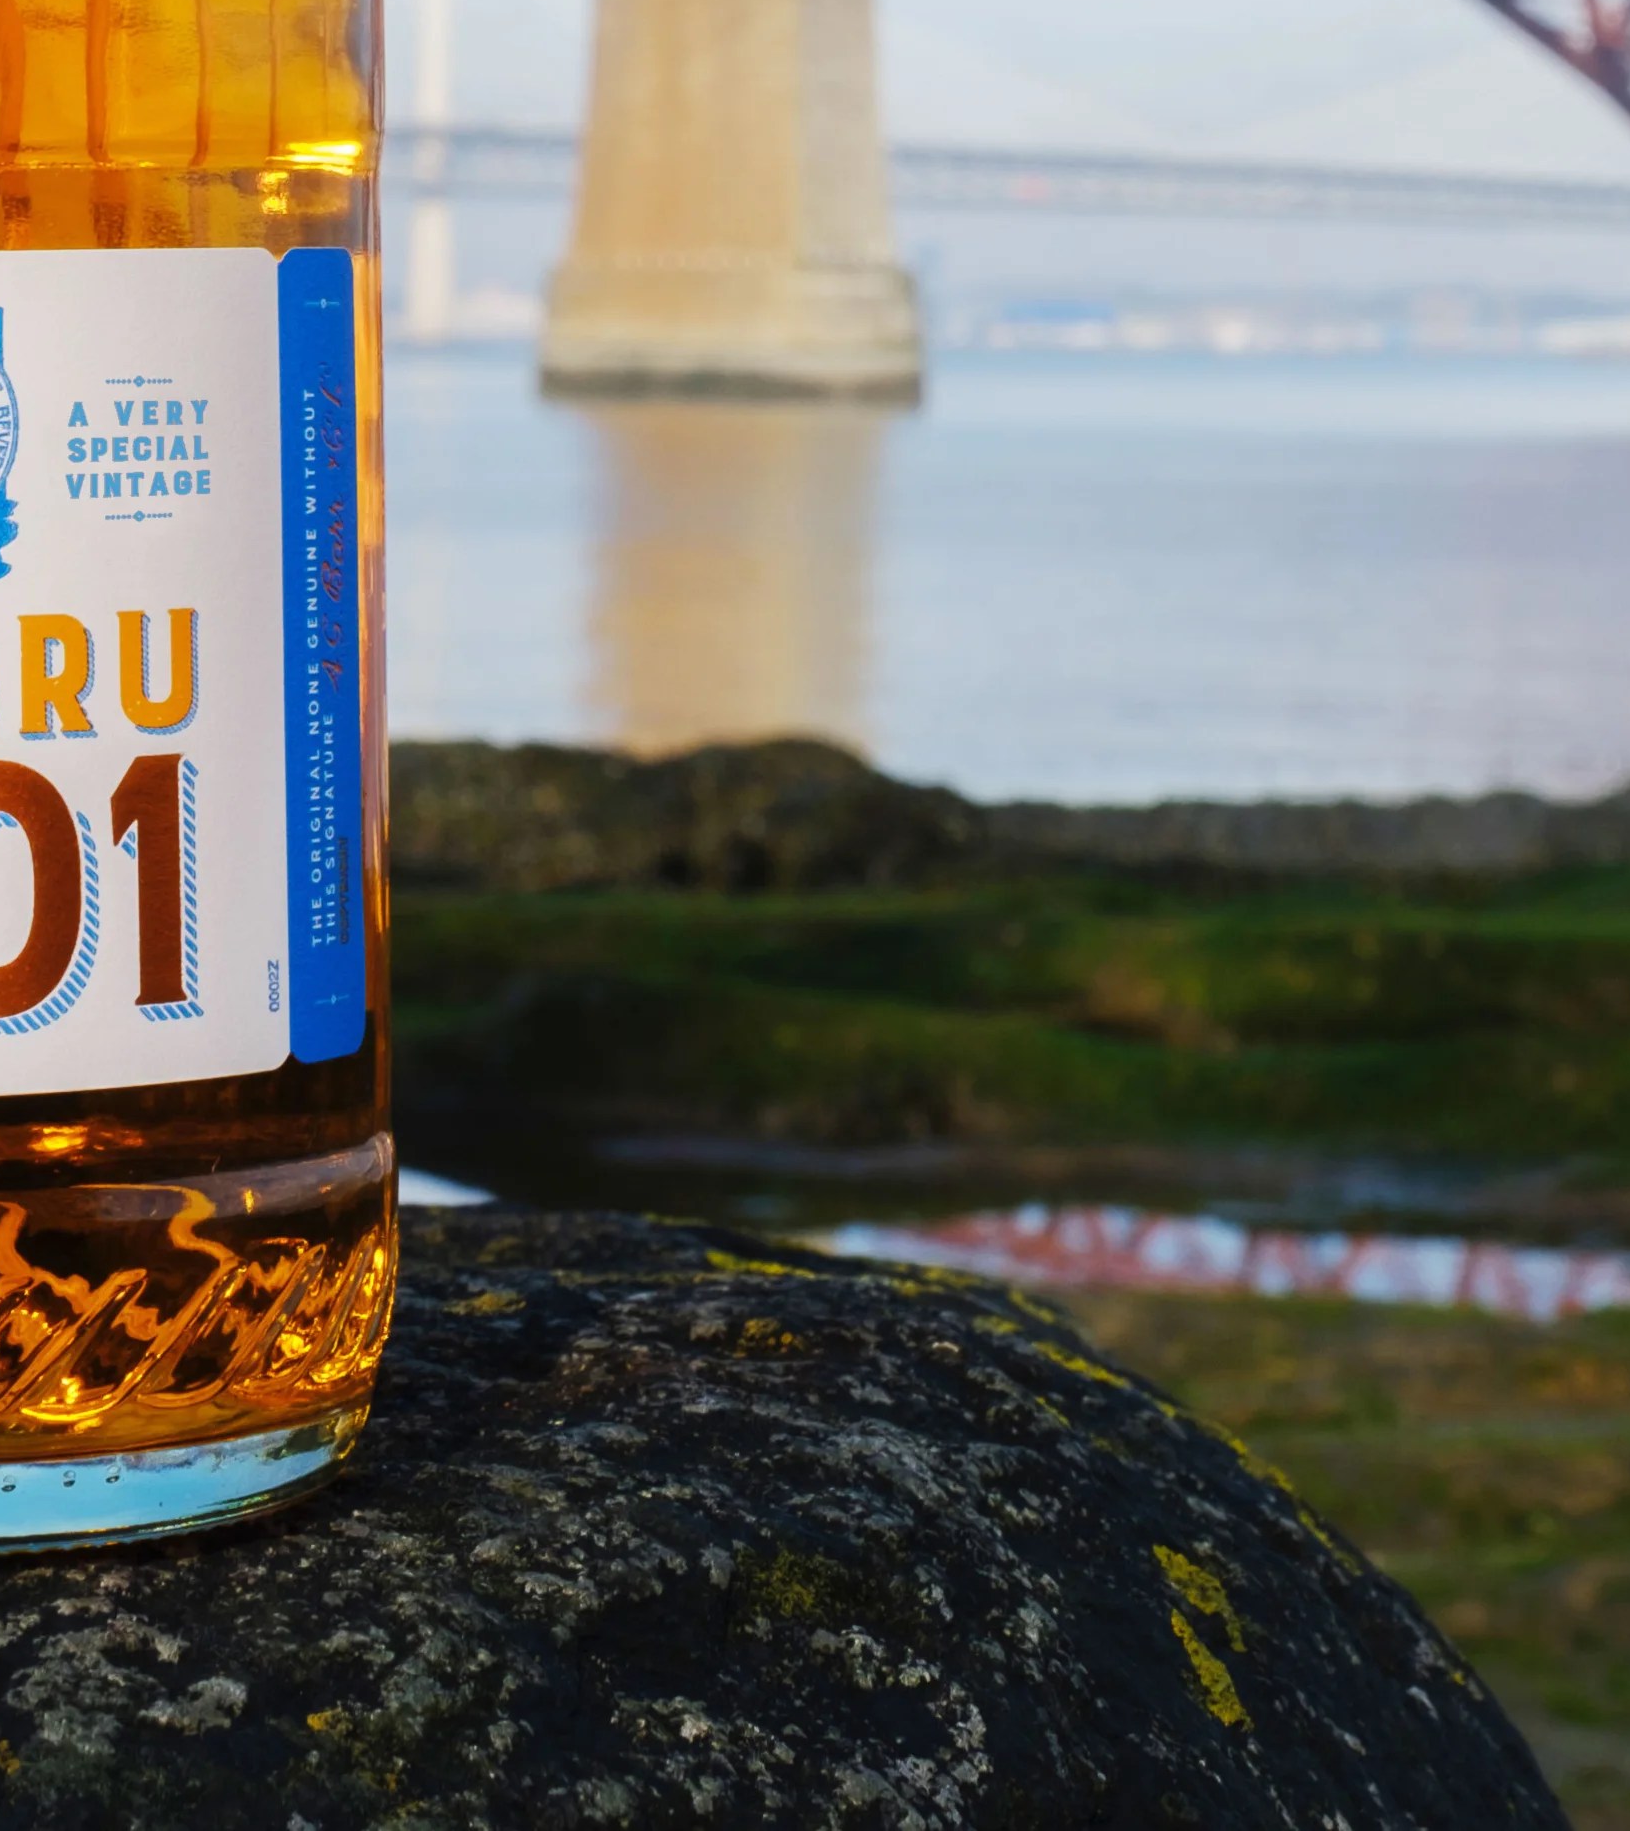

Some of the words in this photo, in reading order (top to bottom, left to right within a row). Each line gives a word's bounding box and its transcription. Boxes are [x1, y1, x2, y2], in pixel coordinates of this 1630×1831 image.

[67, 401, 89, 427] A
[114, 399, 209, 426] VERY
[66, 435, 209, 464] SPECIAL
[303, 389, 317, 515] WITHOUT
[65, 469, 211, 499] VINTAGE
[305, 529, 319, 649] GENUINE
[307, 662, 320, 736] NONE
[308, 748, 322, 884] ORIGINAL
[323, 713, 336, 869] SIGNATURE
[310, 897, 323, 948] THE
[325, 882, 337, 945] THIS
